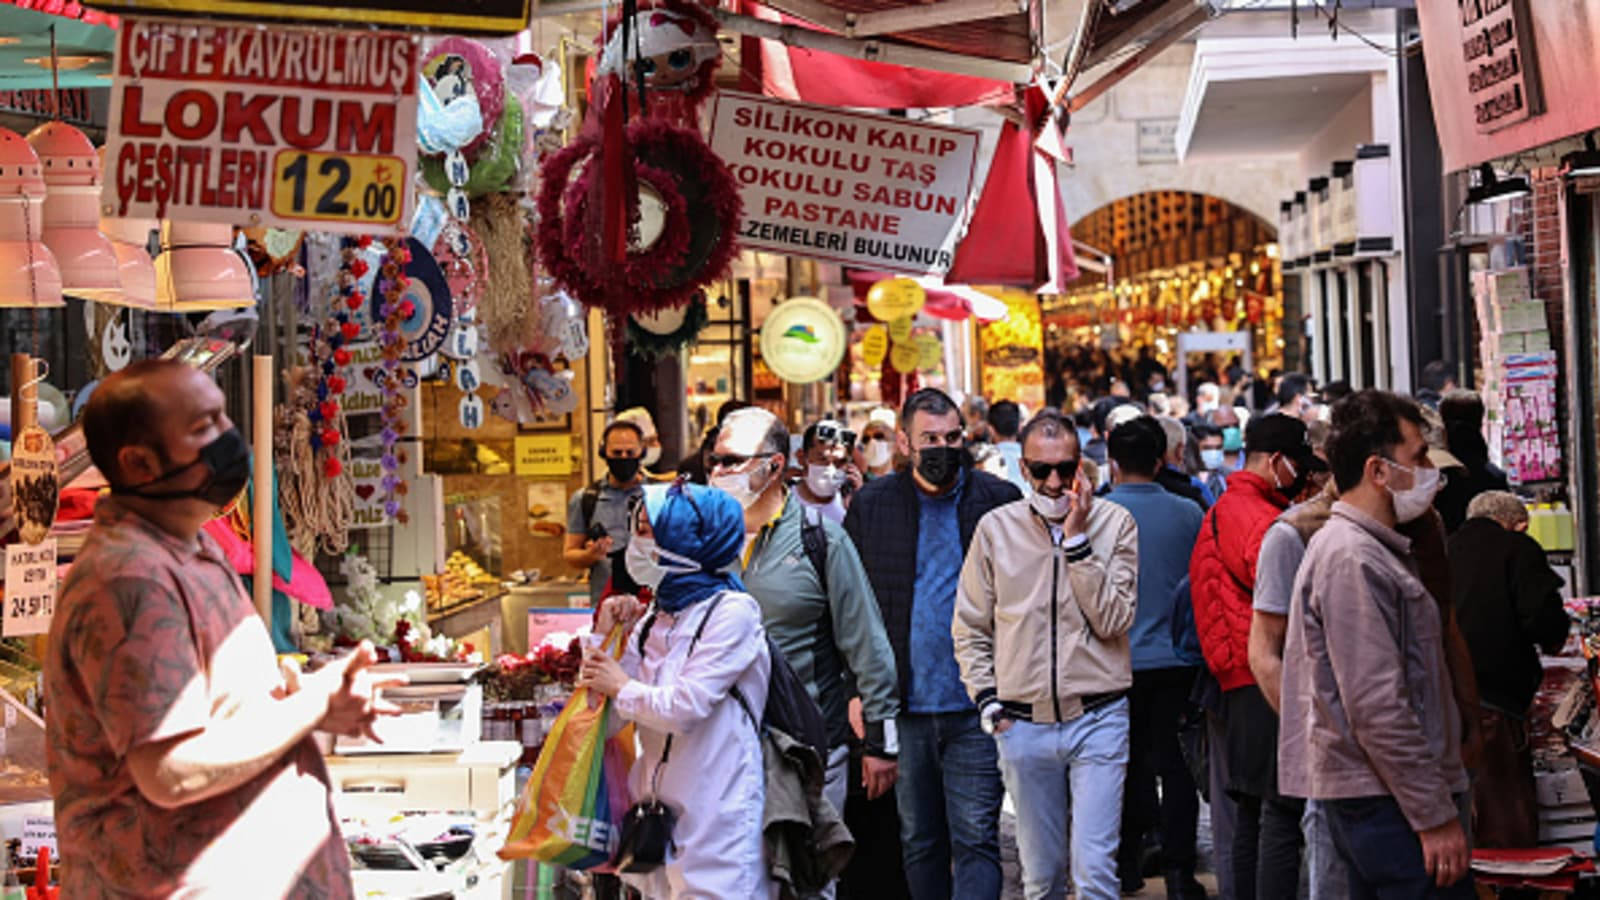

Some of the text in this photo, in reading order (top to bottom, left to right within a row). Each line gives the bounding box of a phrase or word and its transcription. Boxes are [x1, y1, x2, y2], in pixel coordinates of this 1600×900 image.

[222, 27, 409, 99] KAVRULMUŞ
[119, 85, 397, 155] LOKUM
[733, 105, 958, 157] SİLİKON KALIP
[283, 154, 397, 219] 12.00
[743, 137, 937, 188] KOKULU TAŞ
[763, 197, 901, 235] PASTANE
[853, 183, 957, 216] SABUN
[854, 236, 952, 268] BULUNUR
